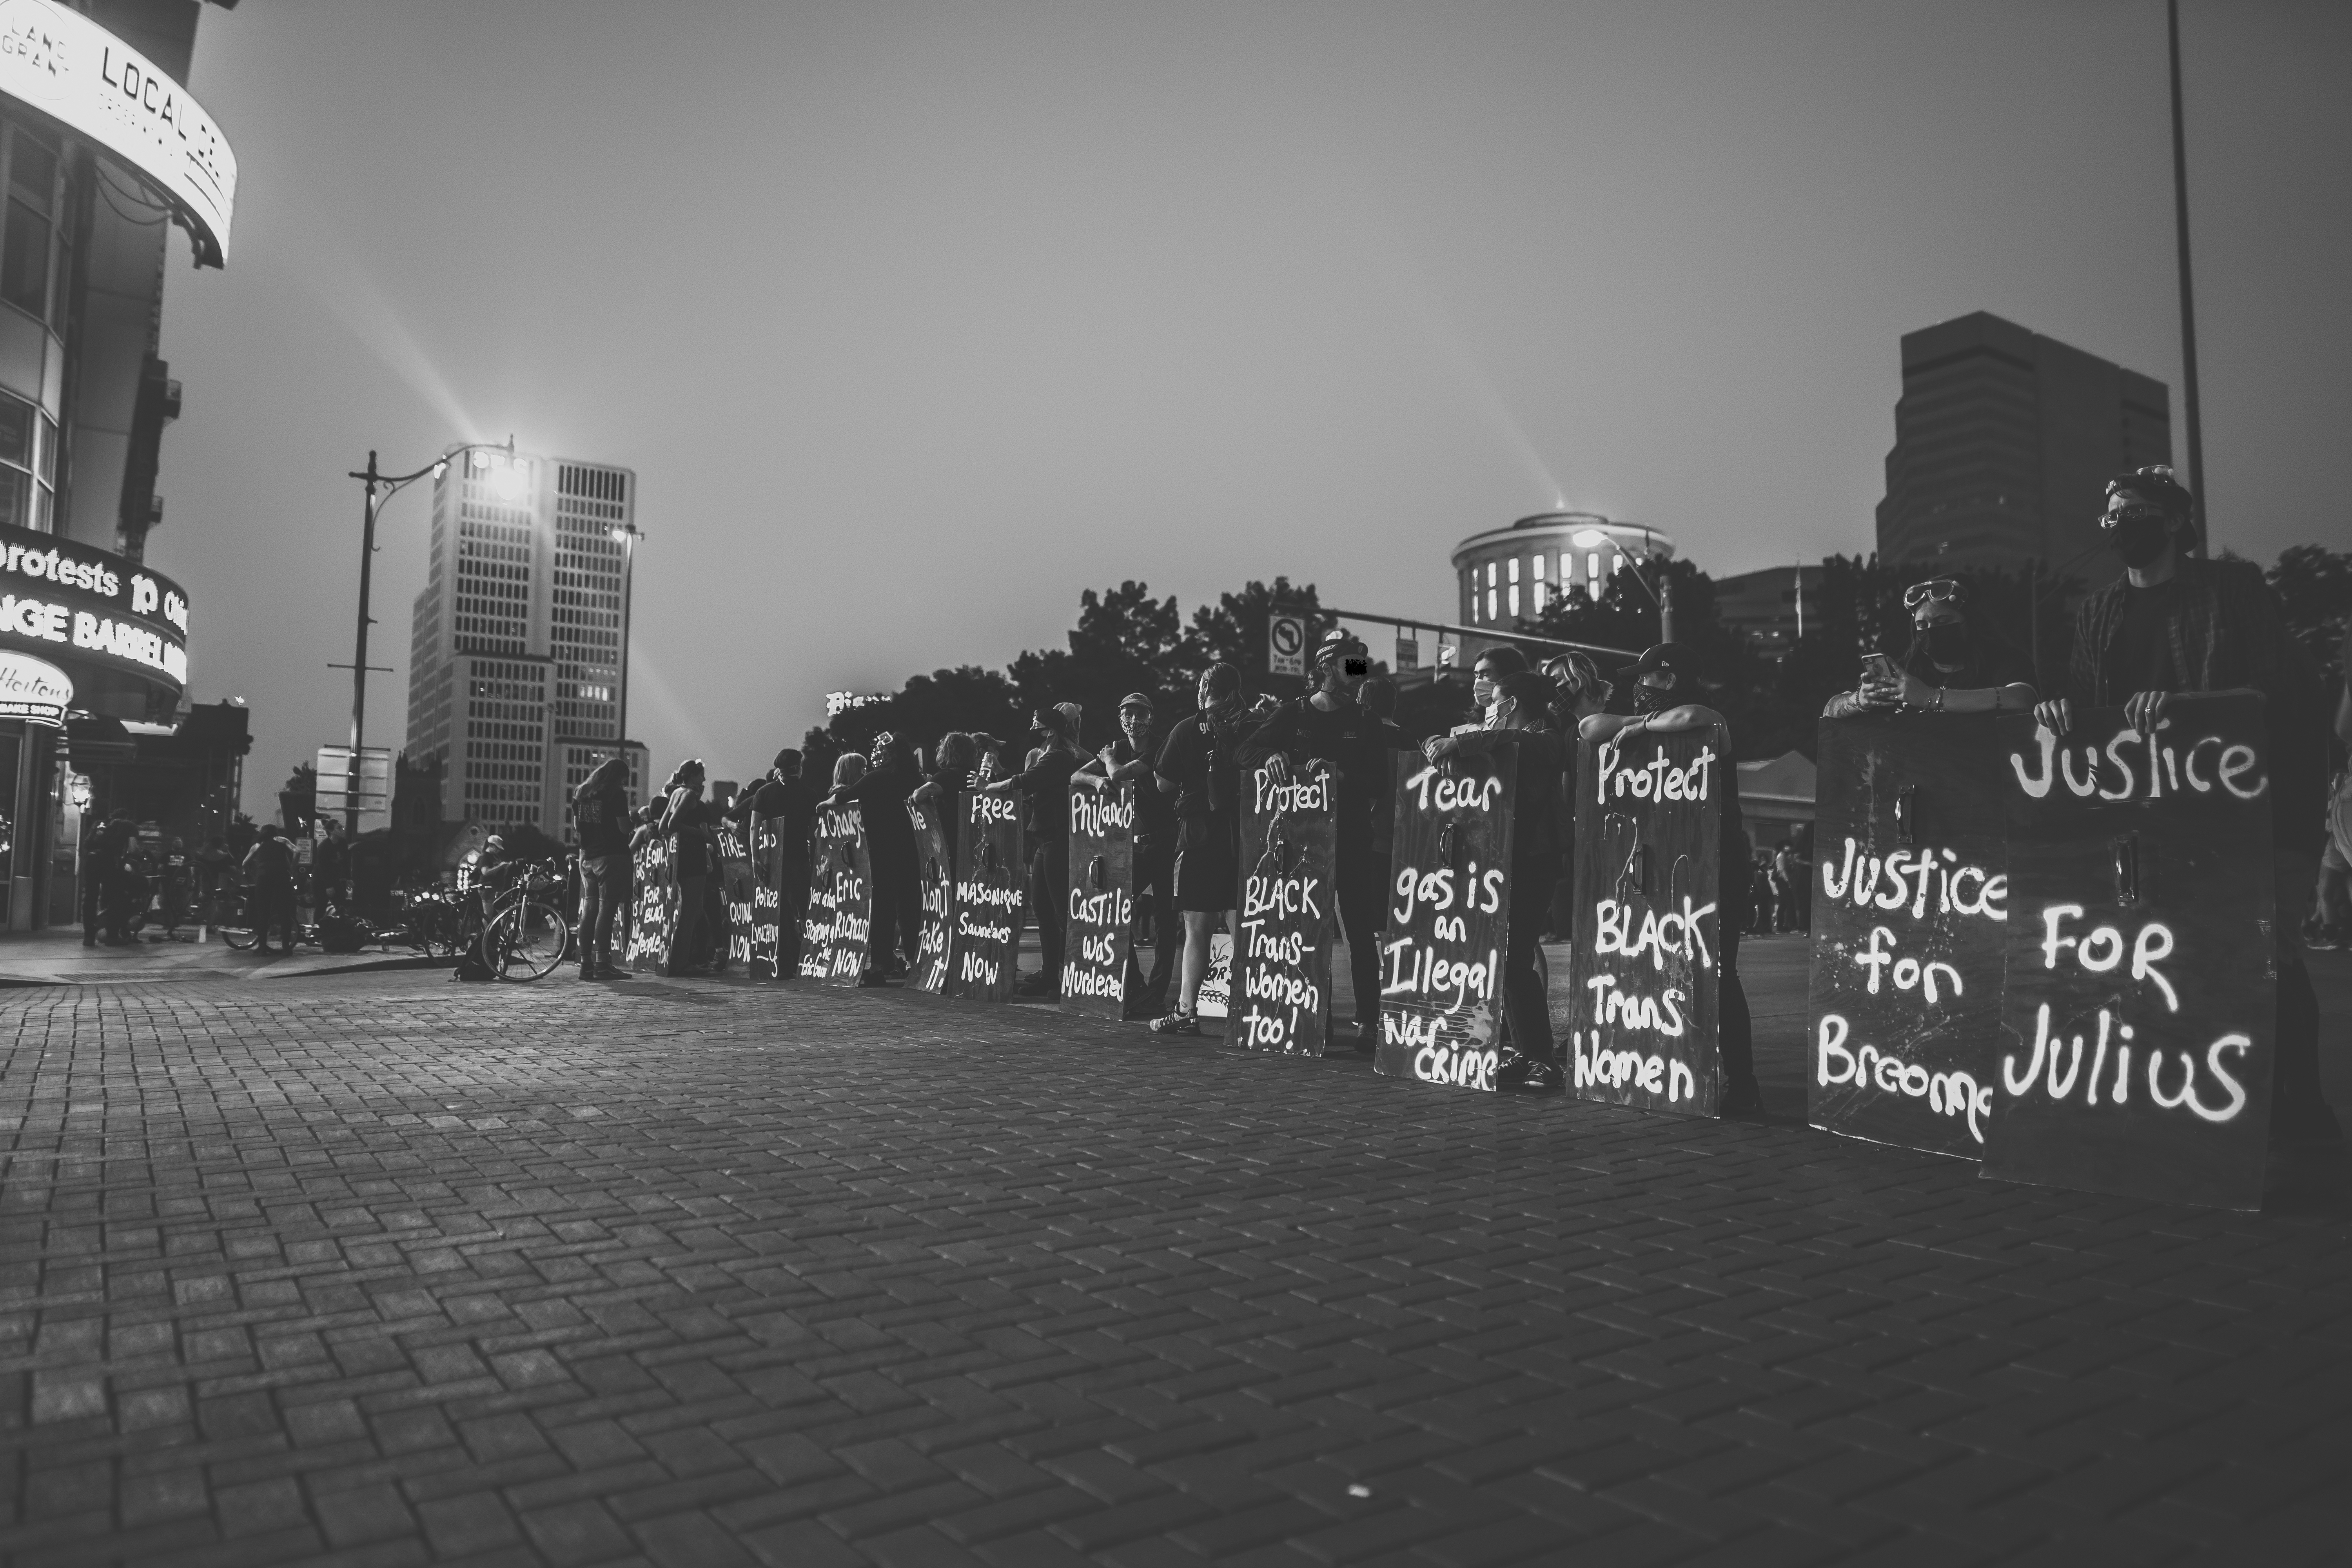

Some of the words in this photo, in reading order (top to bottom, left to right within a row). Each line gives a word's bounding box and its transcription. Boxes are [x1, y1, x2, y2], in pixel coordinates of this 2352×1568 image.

[2, 34, 69, 79] GRANT
[102, 46, 187, 142] LOCAL
[0, 539, 119, 597] rotests
[73, 611, 164, 669] BARREL
[30, 704, 60, 717] SHOP
[1598, 742, 1716, 805] Protect
[2010, 720, 2268, 800] Justice
[1254, 768, 1330, 814] Protect
[1406, 766, 1501, 811] Tear
[759, 826, 776, 849] END
[906, 805, 926, 831] We
[646, 846, 664, 868] EQUI
[717, 832, 746, 858] FIRE
[643, 885, 660, 906] FOR
[755, 887, 778, 909] Police
[837, 868, 862, 903] Eric
[921, 865, 949, 919] Won't
[956, 882, 1022, 914] MASONIQUE
[1244, 876, 1320, 920] BLACK
[1394, 867, 1454, 924] gas
[1467, 861, 1504, 913] is
[1822, 837, 2007, 921] Justice
[635, 931, 661, 958] People
[1241, 919, 1315, 965] Trans-
[1434, 915, 1466, 942] an
[1595, 895, 1716, 971] BLACK
[831, 947, 864, 977] NOW
[961, 951, 998, 985] NOW
[1061, 959, 1127, 1002] Murdered
[1381, 937, 1497, 1014] Illegal
[2040, 903, 2179, 1013] FOR
[1246, 963, 1318, 1014] Women
[1587, 974, 1686, 1037] Trans
[1243, 1004, 1298, 1050] too!
[1573, 1030, 1694, 1103] Women
[2002, 1002, 2251, 1123] Julius
